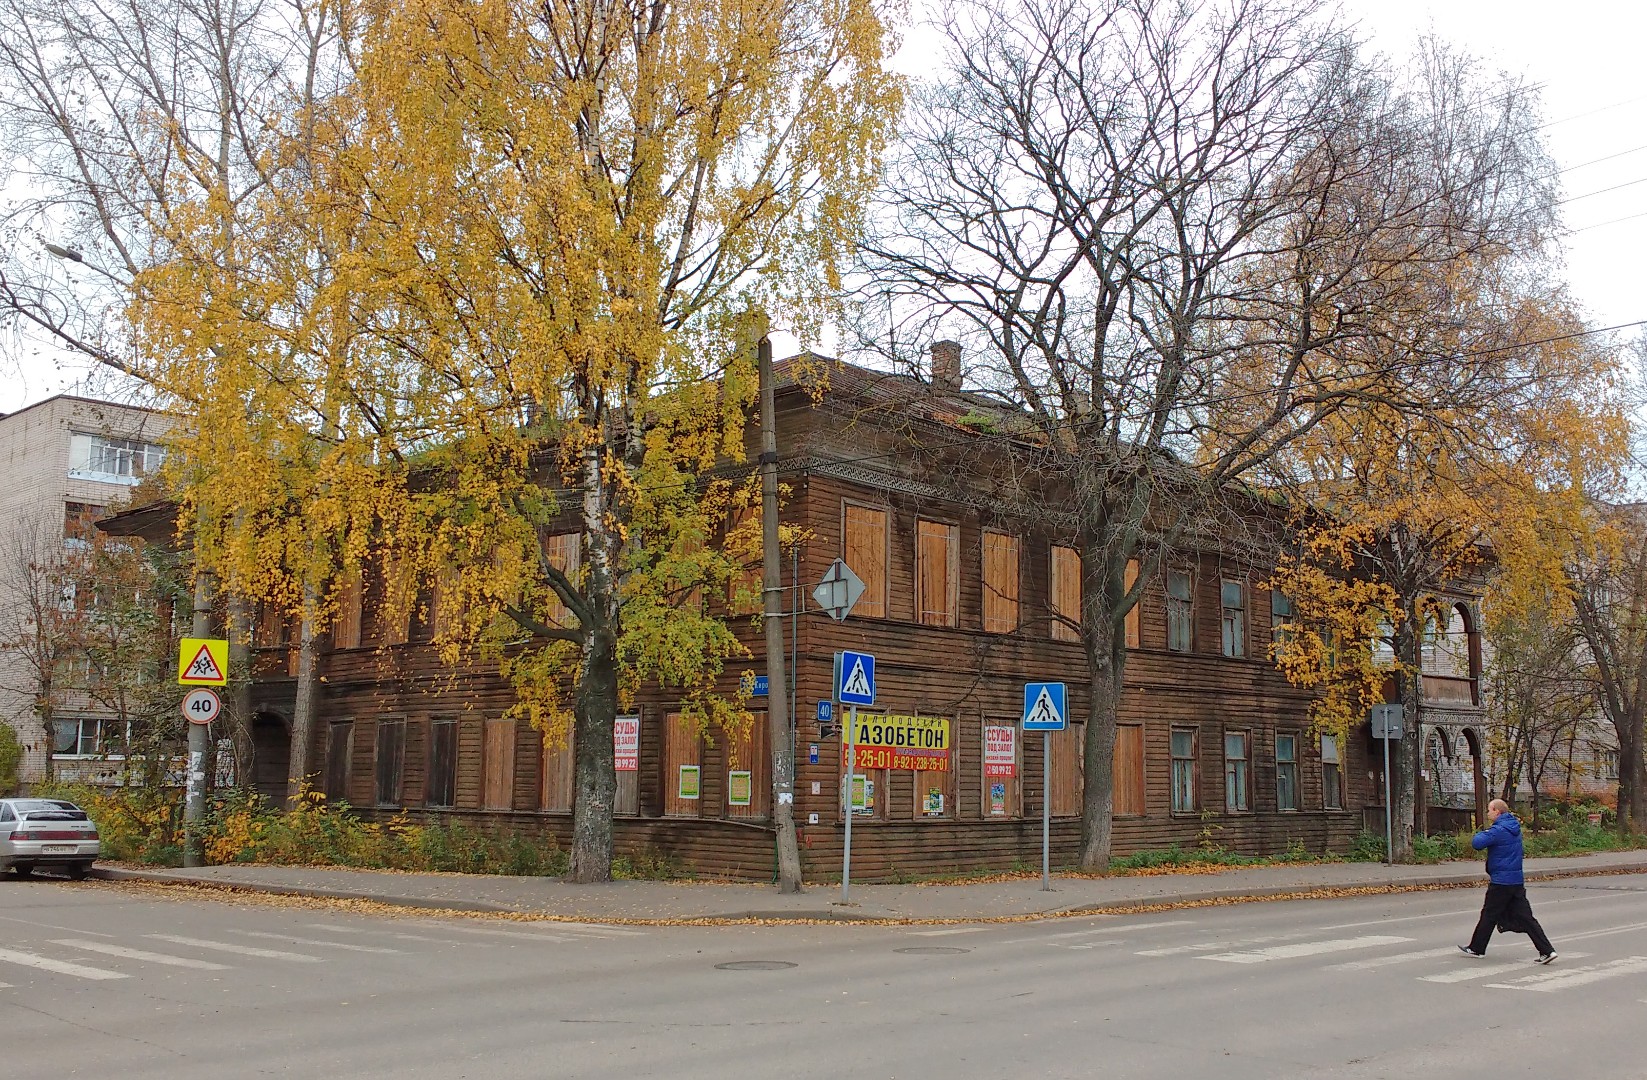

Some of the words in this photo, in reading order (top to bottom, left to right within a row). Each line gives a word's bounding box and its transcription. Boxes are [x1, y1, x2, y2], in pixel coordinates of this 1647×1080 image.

[754, 681, 768, 690] Киро
[191, 699, 212, 712] 40
[820, 704, 830, 717] 40
[614, 722, 637, 734] СУДЫ
[855, 724, 943, 747] АЗОБЕТОН
[987, 730, 1012, 741] ССУДЫ
[998, 743, 1012, 753] ЗАЛОГ
[629, 759, 636, 768] 22
[992, 766, 998, 774] 50
[999, 766, 1005, 774] 99
[1006, 766, 1011, 774] 22
